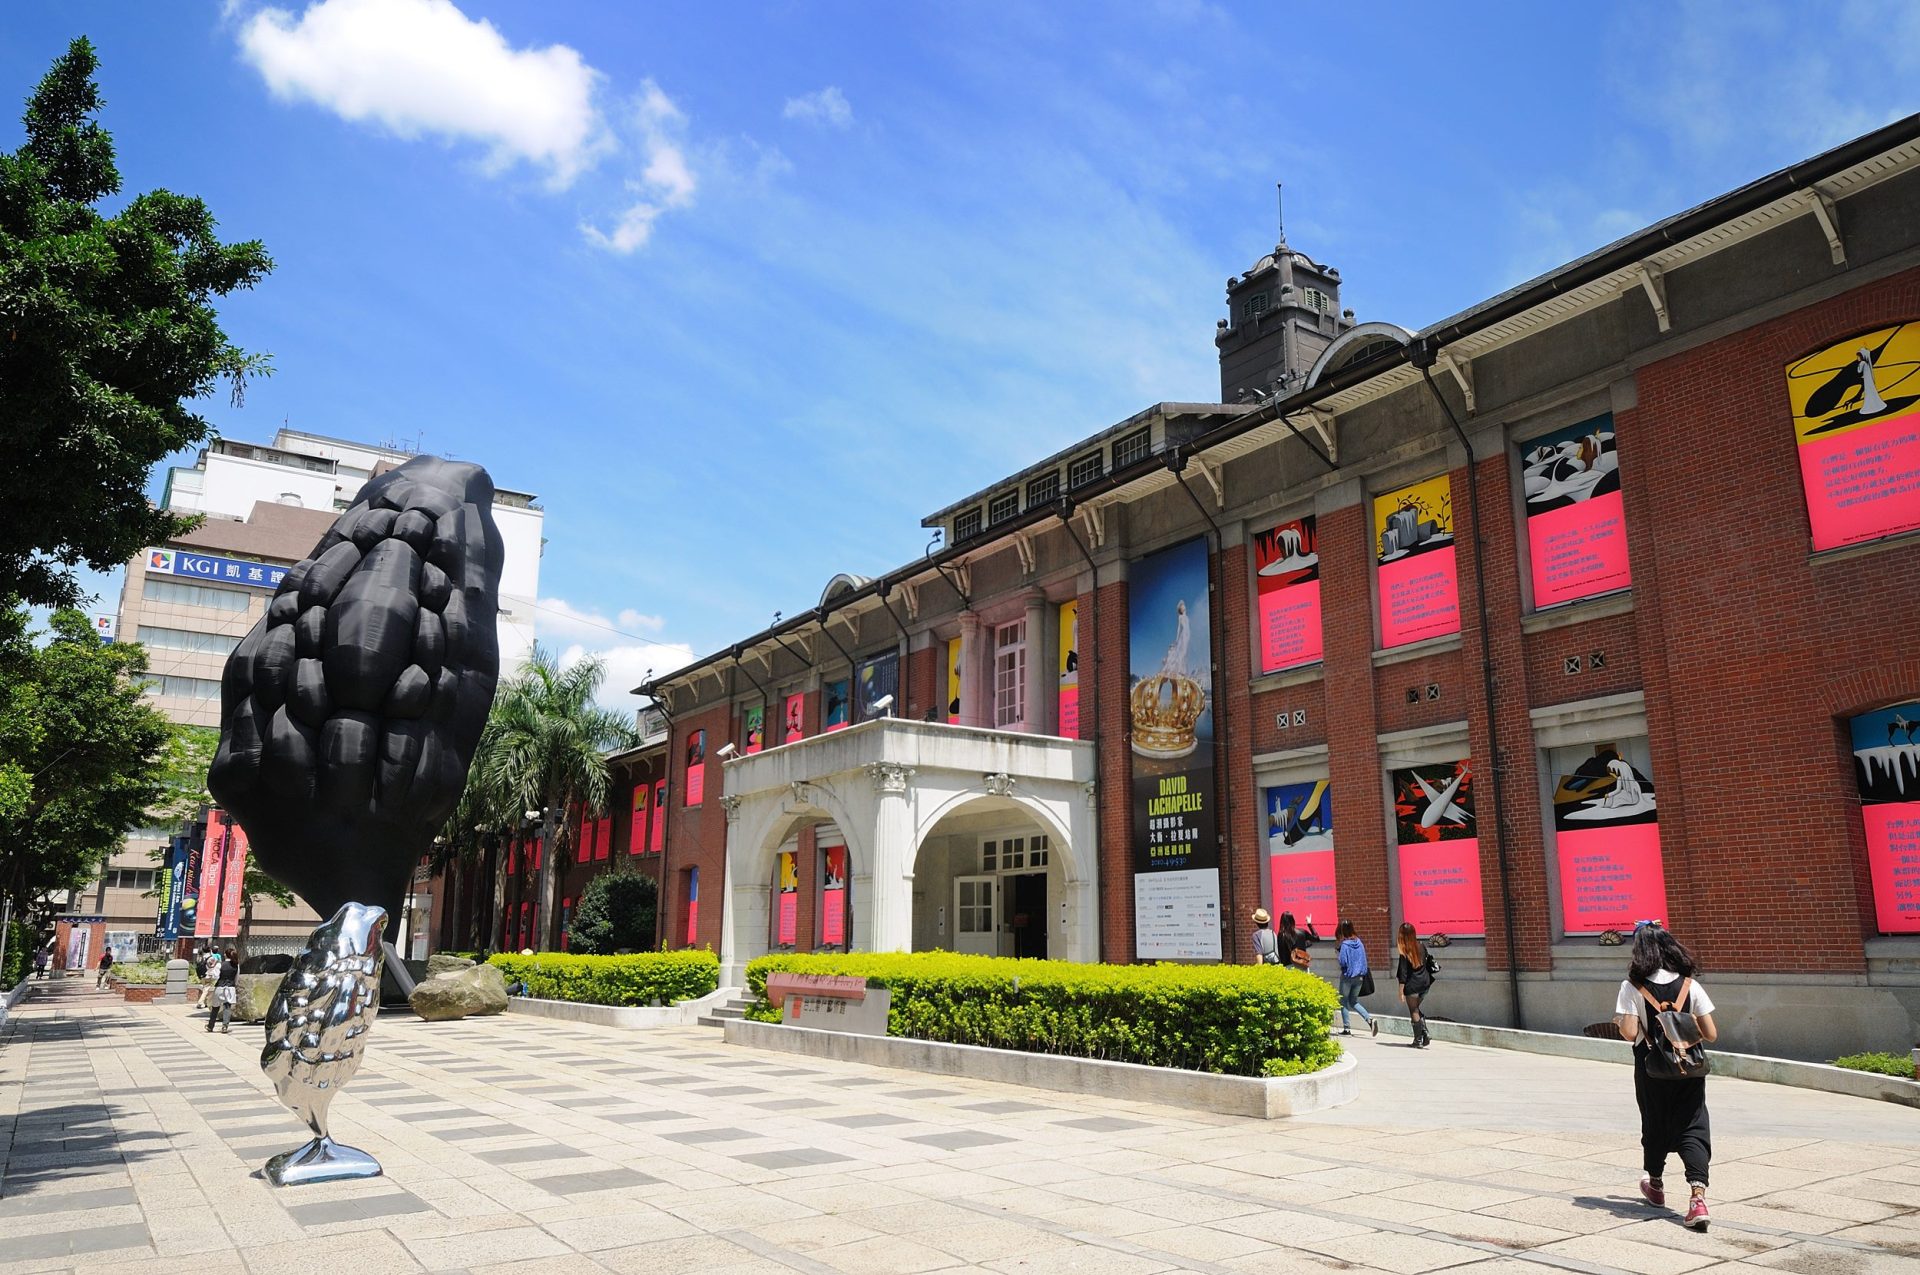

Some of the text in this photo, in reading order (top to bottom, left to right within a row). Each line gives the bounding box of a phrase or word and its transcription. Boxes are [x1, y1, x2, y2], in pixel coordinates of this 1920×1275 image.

[182, 557, 219, 575] KGI
[1159, 776, 1187, 796] DAVID
[1148, 792, 1202, 816] LACHAPELLE
